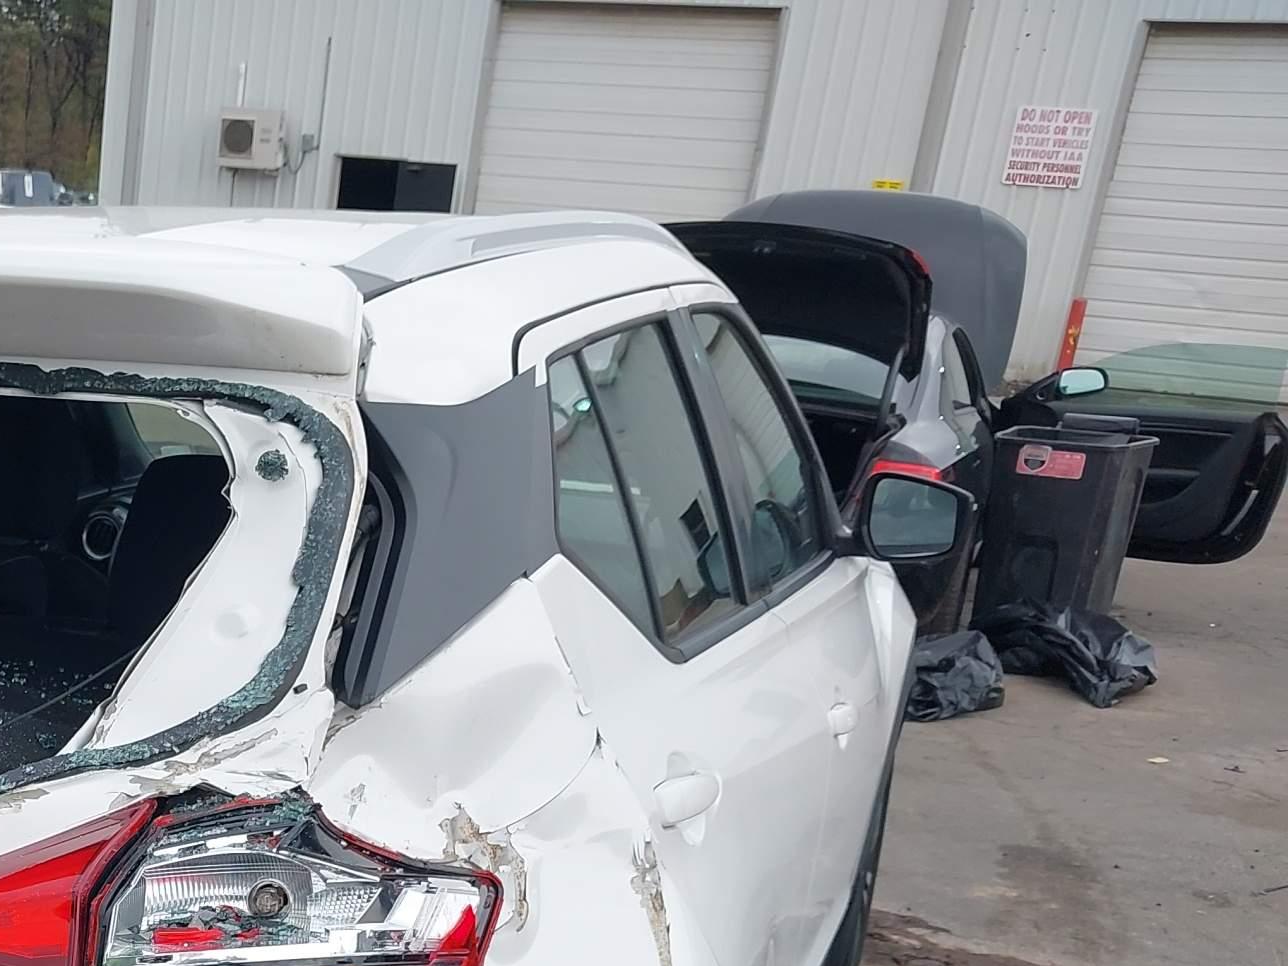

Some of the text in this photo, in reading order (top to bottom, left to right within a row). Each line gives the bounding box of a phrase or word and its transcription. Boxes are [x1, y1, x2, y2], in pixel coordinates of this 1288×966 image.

[1020, 108, 1093, 125] DO NOT OPEN
[1015, 123, 1091, 137] HOODS OR TRY
[1013, 136, 1089, 150] TO START VEHICLES
[1011, 148, 1083, 162] WITHOUT IAA
[1008, 160, 1081, 174] SECURITY PERSONNEL
[1005, 172, 1080, 187] AUTHORIZATION
